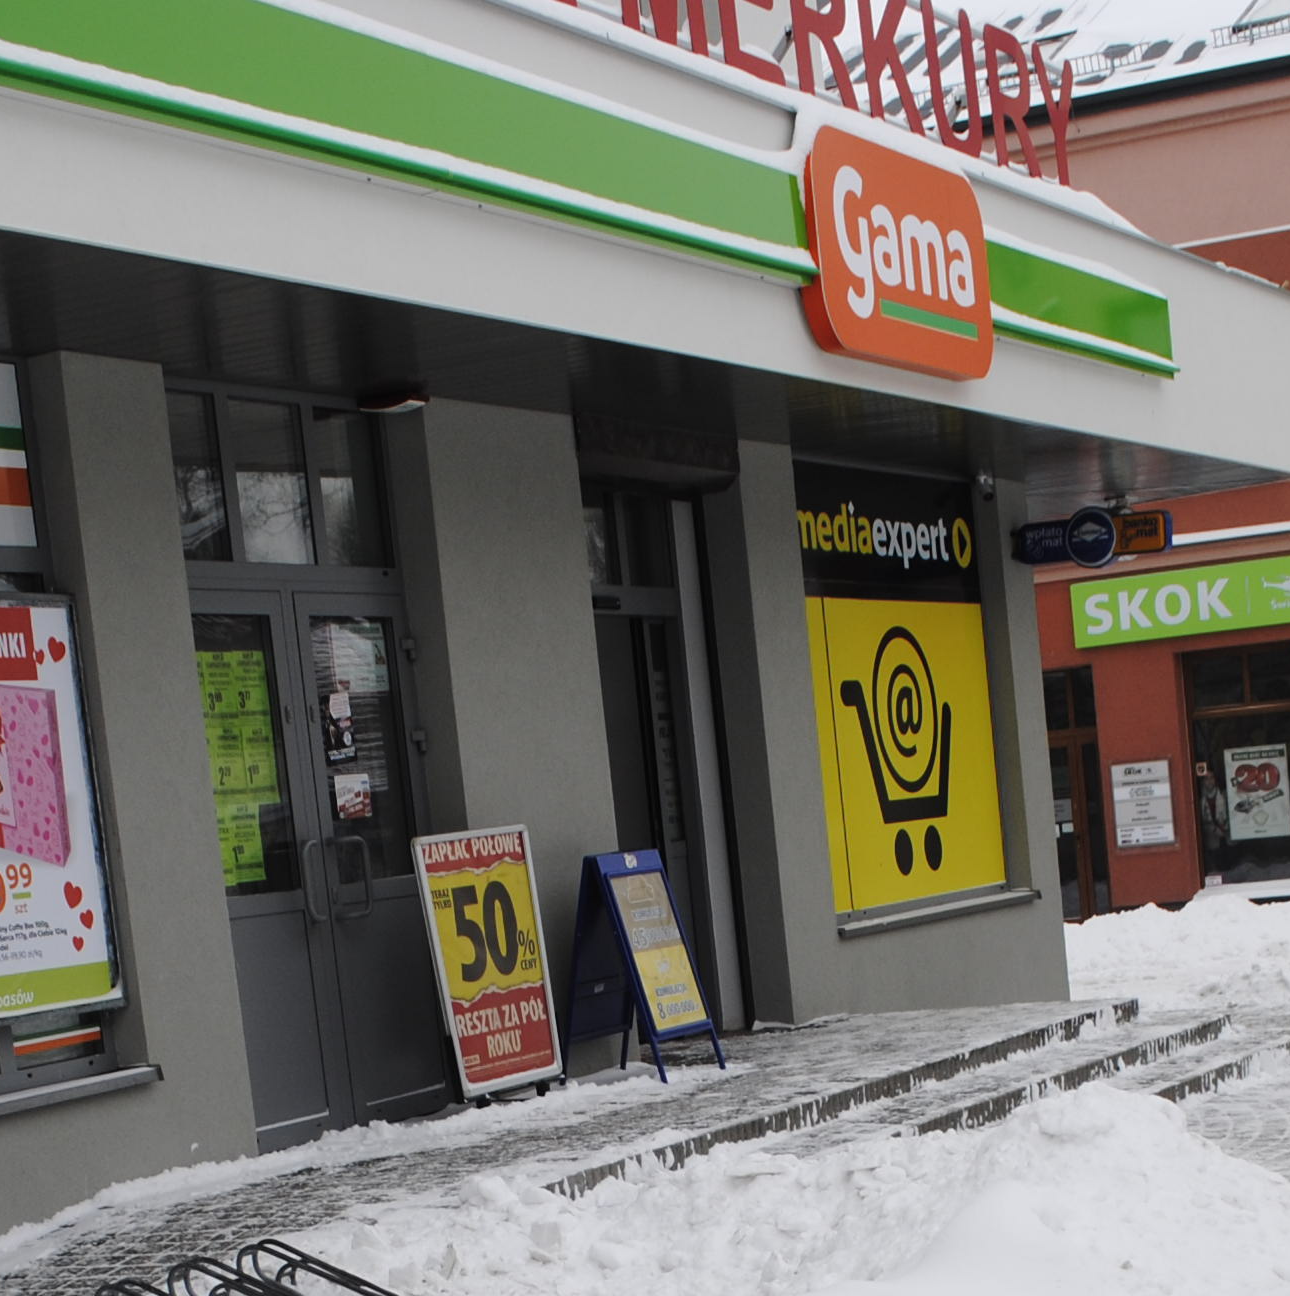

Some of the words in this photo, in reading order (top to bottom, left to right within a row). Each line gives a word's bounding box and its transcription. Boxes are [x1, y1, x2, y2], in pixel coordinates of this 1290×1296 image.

[797, 501, 950, 570] mediaexpert
[1084, 578, 1233, 636] SKOK
[1235, 762, 1281, 793] 20
[470, 832, 522, 858] POŁOWĘ
[14, 904, 29, 914] szt
[520, 958, 537, 971] CENY
[455, 1007, 502, 1038] RESZTA
[501, 1003, 521, 1028] ZA
[520, 996, 547, 1024] PÓŁ
